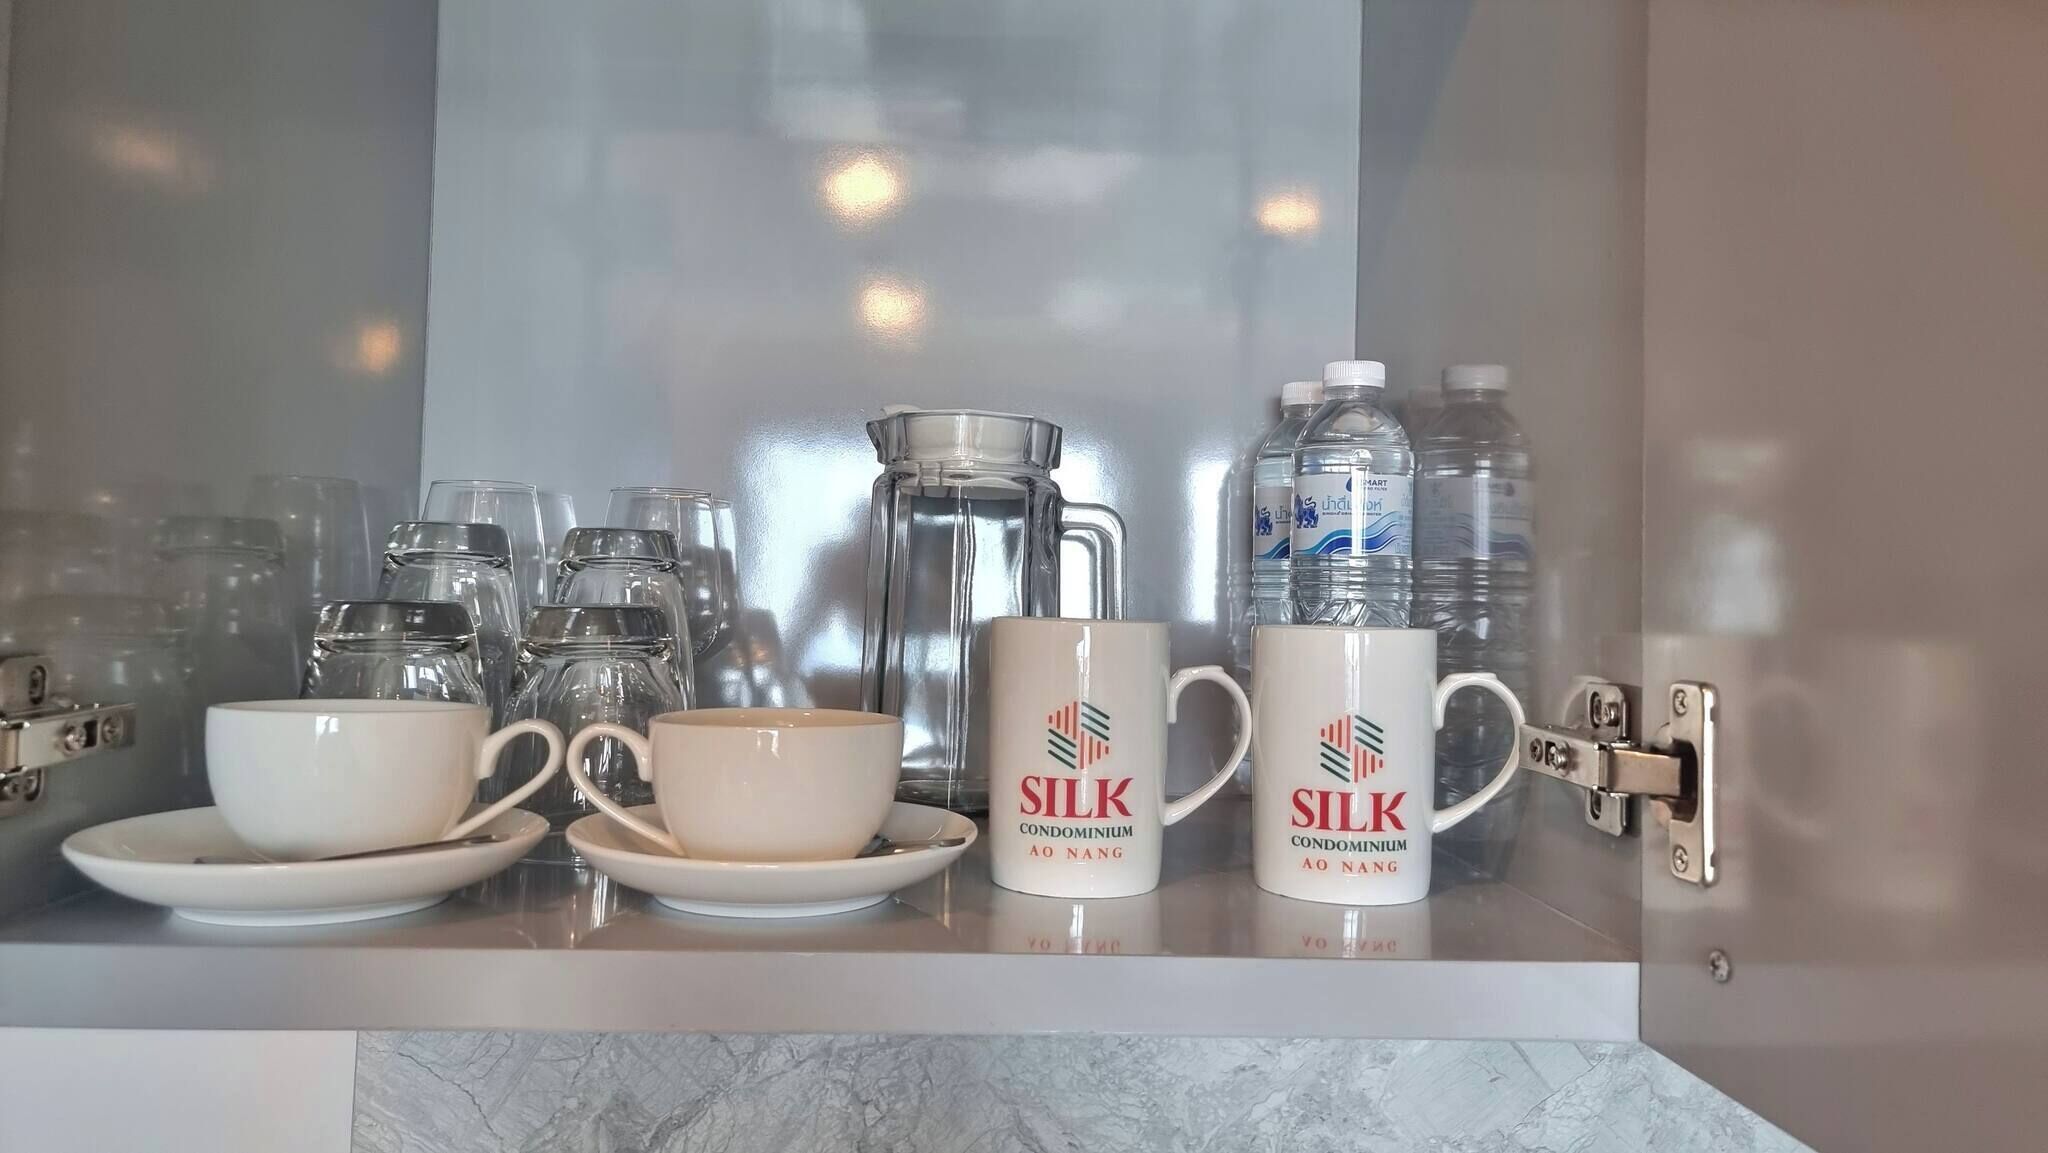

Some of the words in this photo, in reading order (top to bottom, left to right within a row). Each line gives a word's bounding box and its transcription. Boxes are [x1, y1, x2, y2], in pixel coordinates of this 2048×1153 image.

[1020, 775, 1134, 819] SILK
[1291, 787, 1407, 832] SILK
[1019, 822, 1133, 839] CONDOMINIUM
[1291, 835, 1407, 852] CONDOMINIUM
[1029, 845, 1054, 858] AO
[1067, 847, 1123, 860] NANG
[1302, 858, 1328, 871] AO
[1341, 860, 1398, 873] NANG
